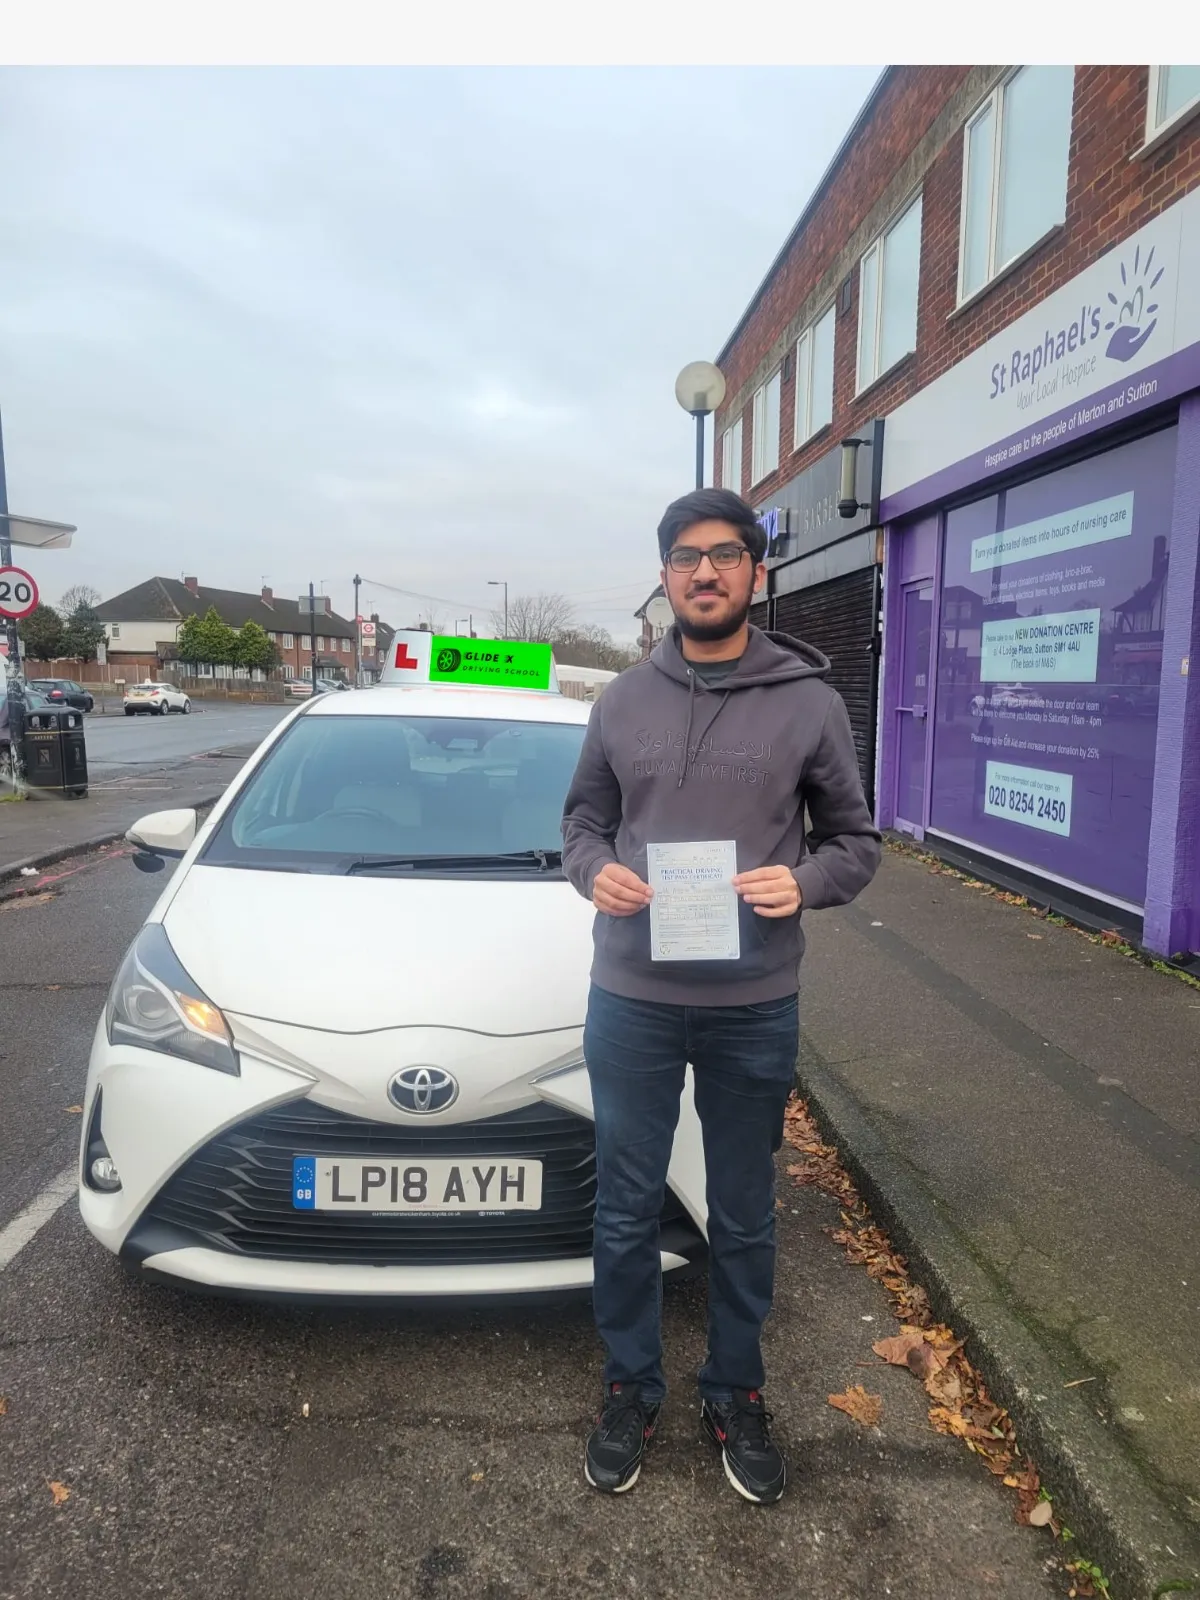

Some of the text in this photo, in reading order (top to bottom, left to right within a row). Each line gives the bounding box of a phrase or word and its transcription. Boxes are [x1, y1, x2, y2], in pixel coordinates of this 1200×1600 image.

[990, 305, 1101, 399] St Raphael's
[1017, 354, 1097, 410] Your Local Hospice
[984, 379, 1158, 469] Hospice care to the people of Merton and Sutton
[975, 508, 1127, 559] Turn your donated items into hours of nursing care
[0, 582, 32, 603] 20
[1061, 583, 1077, 593] books
[1077, 580, 1088, 591] and
[1088, 577, 1105, 588] media
[1014, 628, 1029, 641] NEW
[1029, 625, 1063, 639] DONATION
[1064, 621, 1094, 636] CENTRE
[395, 643, 418, 670] L
[465, 651, 515, 664] GLIDE X
[1002, 644, 1017, 658] Lodge
[1018, 644, 1034, 656] Place,
[1035, 643, 1053, 655] Sutton
[1054, 641, 1066, 653] SM1
[1067, 641, 1080, 652] 4AU
[462, 666, 540, 677] DRIVING SCHOOL
[1011, 657, 1057, 671] (The back of M&S)
[1045, 699, 1053, 708] the
[1053, 700, 1065, 709] door
[1065, 699, 1076, 710] and
[1076, 702, 1085, 710] our
[1085, 701, 1100, 711] team
[1016, 713, 1024, 722] you
[1024, 711, 1042, 724] Monday
[1042, 713, 1047, 722] to
[1048, 712, 1070, 725] Saturday
[1071, 714, 1085, 725] 10am
[1089, 715, 1102, 727] 4pm
[1027, 742, 1046, 751] increase
[1046, 744, 1058, 754] your
[1058, 745, 1079, 756] donation
[1079, 746, 1087, 760] by
[1087, 747, 1100, 760] 25%
[633, 759, 769, 787] HUMANITYFIRST
[989, 785, 1066, 824] 020 8254 2450
[331, 1165, 525, 1203] LP18 AYH
[296, 1189, 312, 1200] GB
